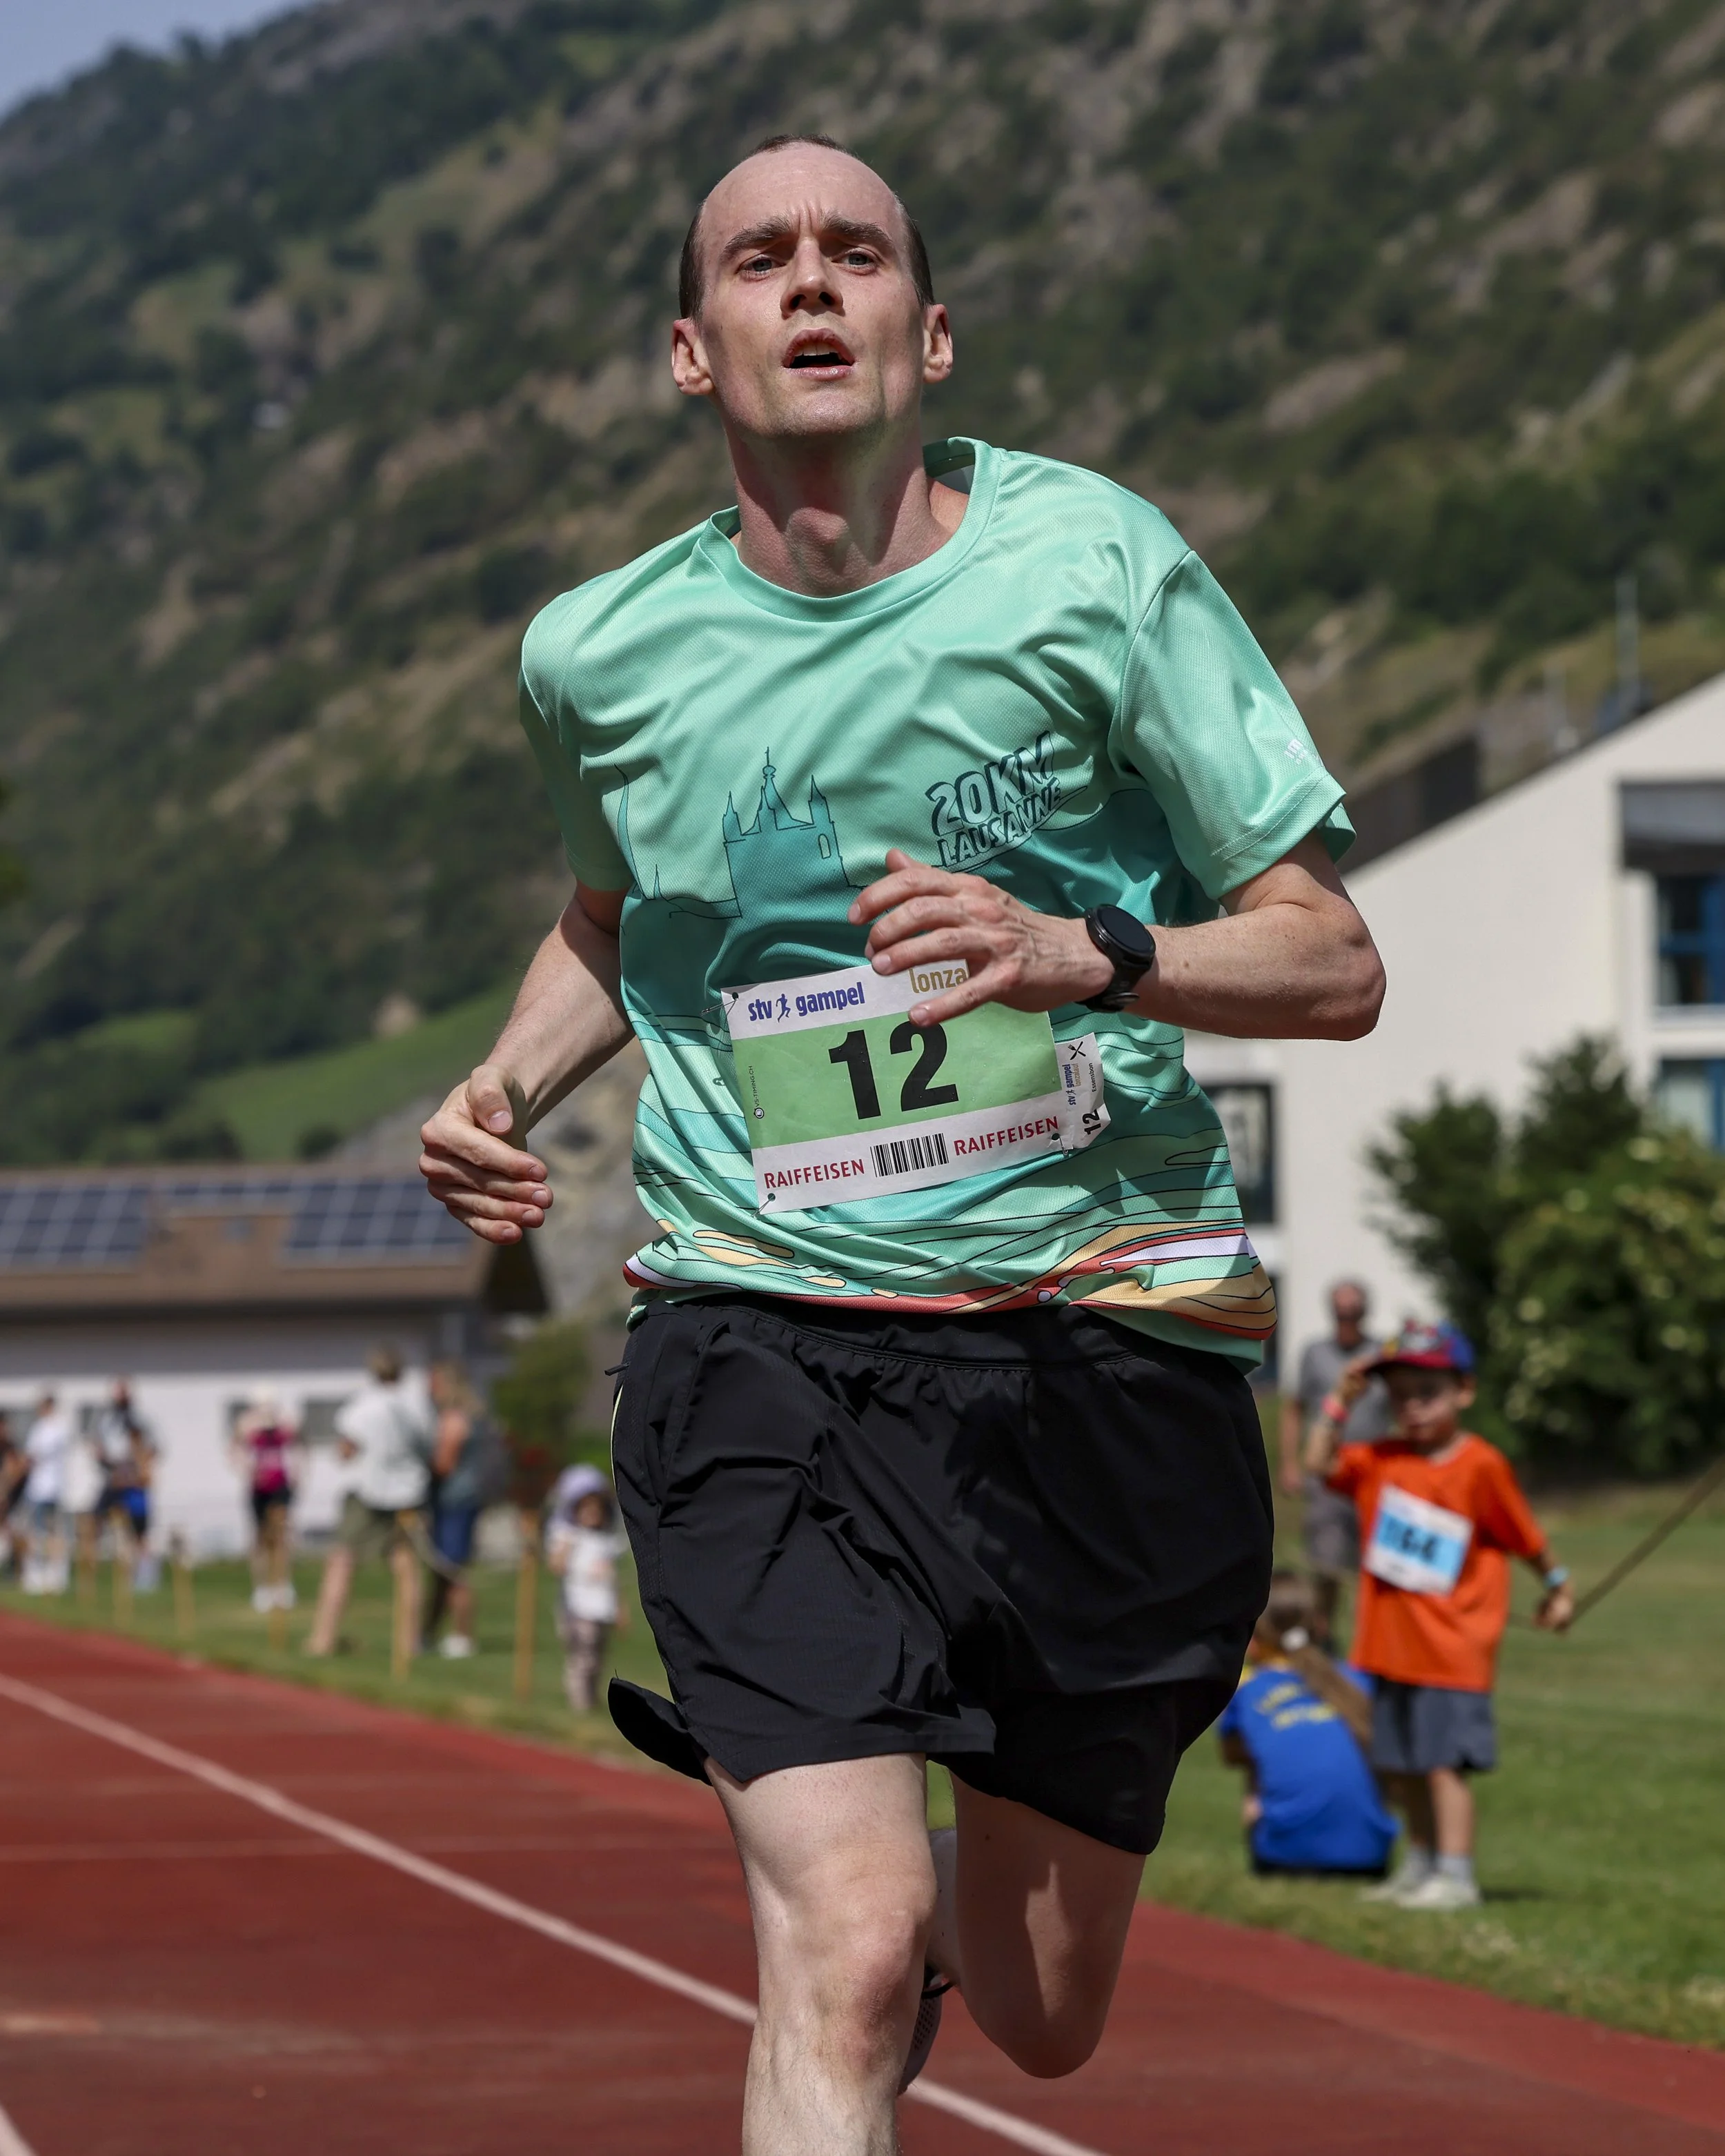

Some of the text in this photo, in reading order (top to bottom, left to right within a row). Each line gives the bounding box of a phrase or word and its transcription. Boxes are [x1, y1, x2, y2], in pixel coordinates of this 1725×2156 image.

[925, 730, 1055, 837] 20KM
[937, 777, 1061, 867] LAUSANNE
[747, 981, 865, 1022] stv gampel
[749, 1065, 760, 1107] VS-TIMING.CH
[828, 1020, 959, 1120] 12
[1062, 1064, 1076, 1105] stv gampel
[1072, 1063, 1081, 1087] lonzalauf
[954, 1116, 1059, 1156] RAIFFEISEN
[1082, 1109, 1101, 1136] 12
[764, 1158, 865, 1189] RAIFFEISEN
